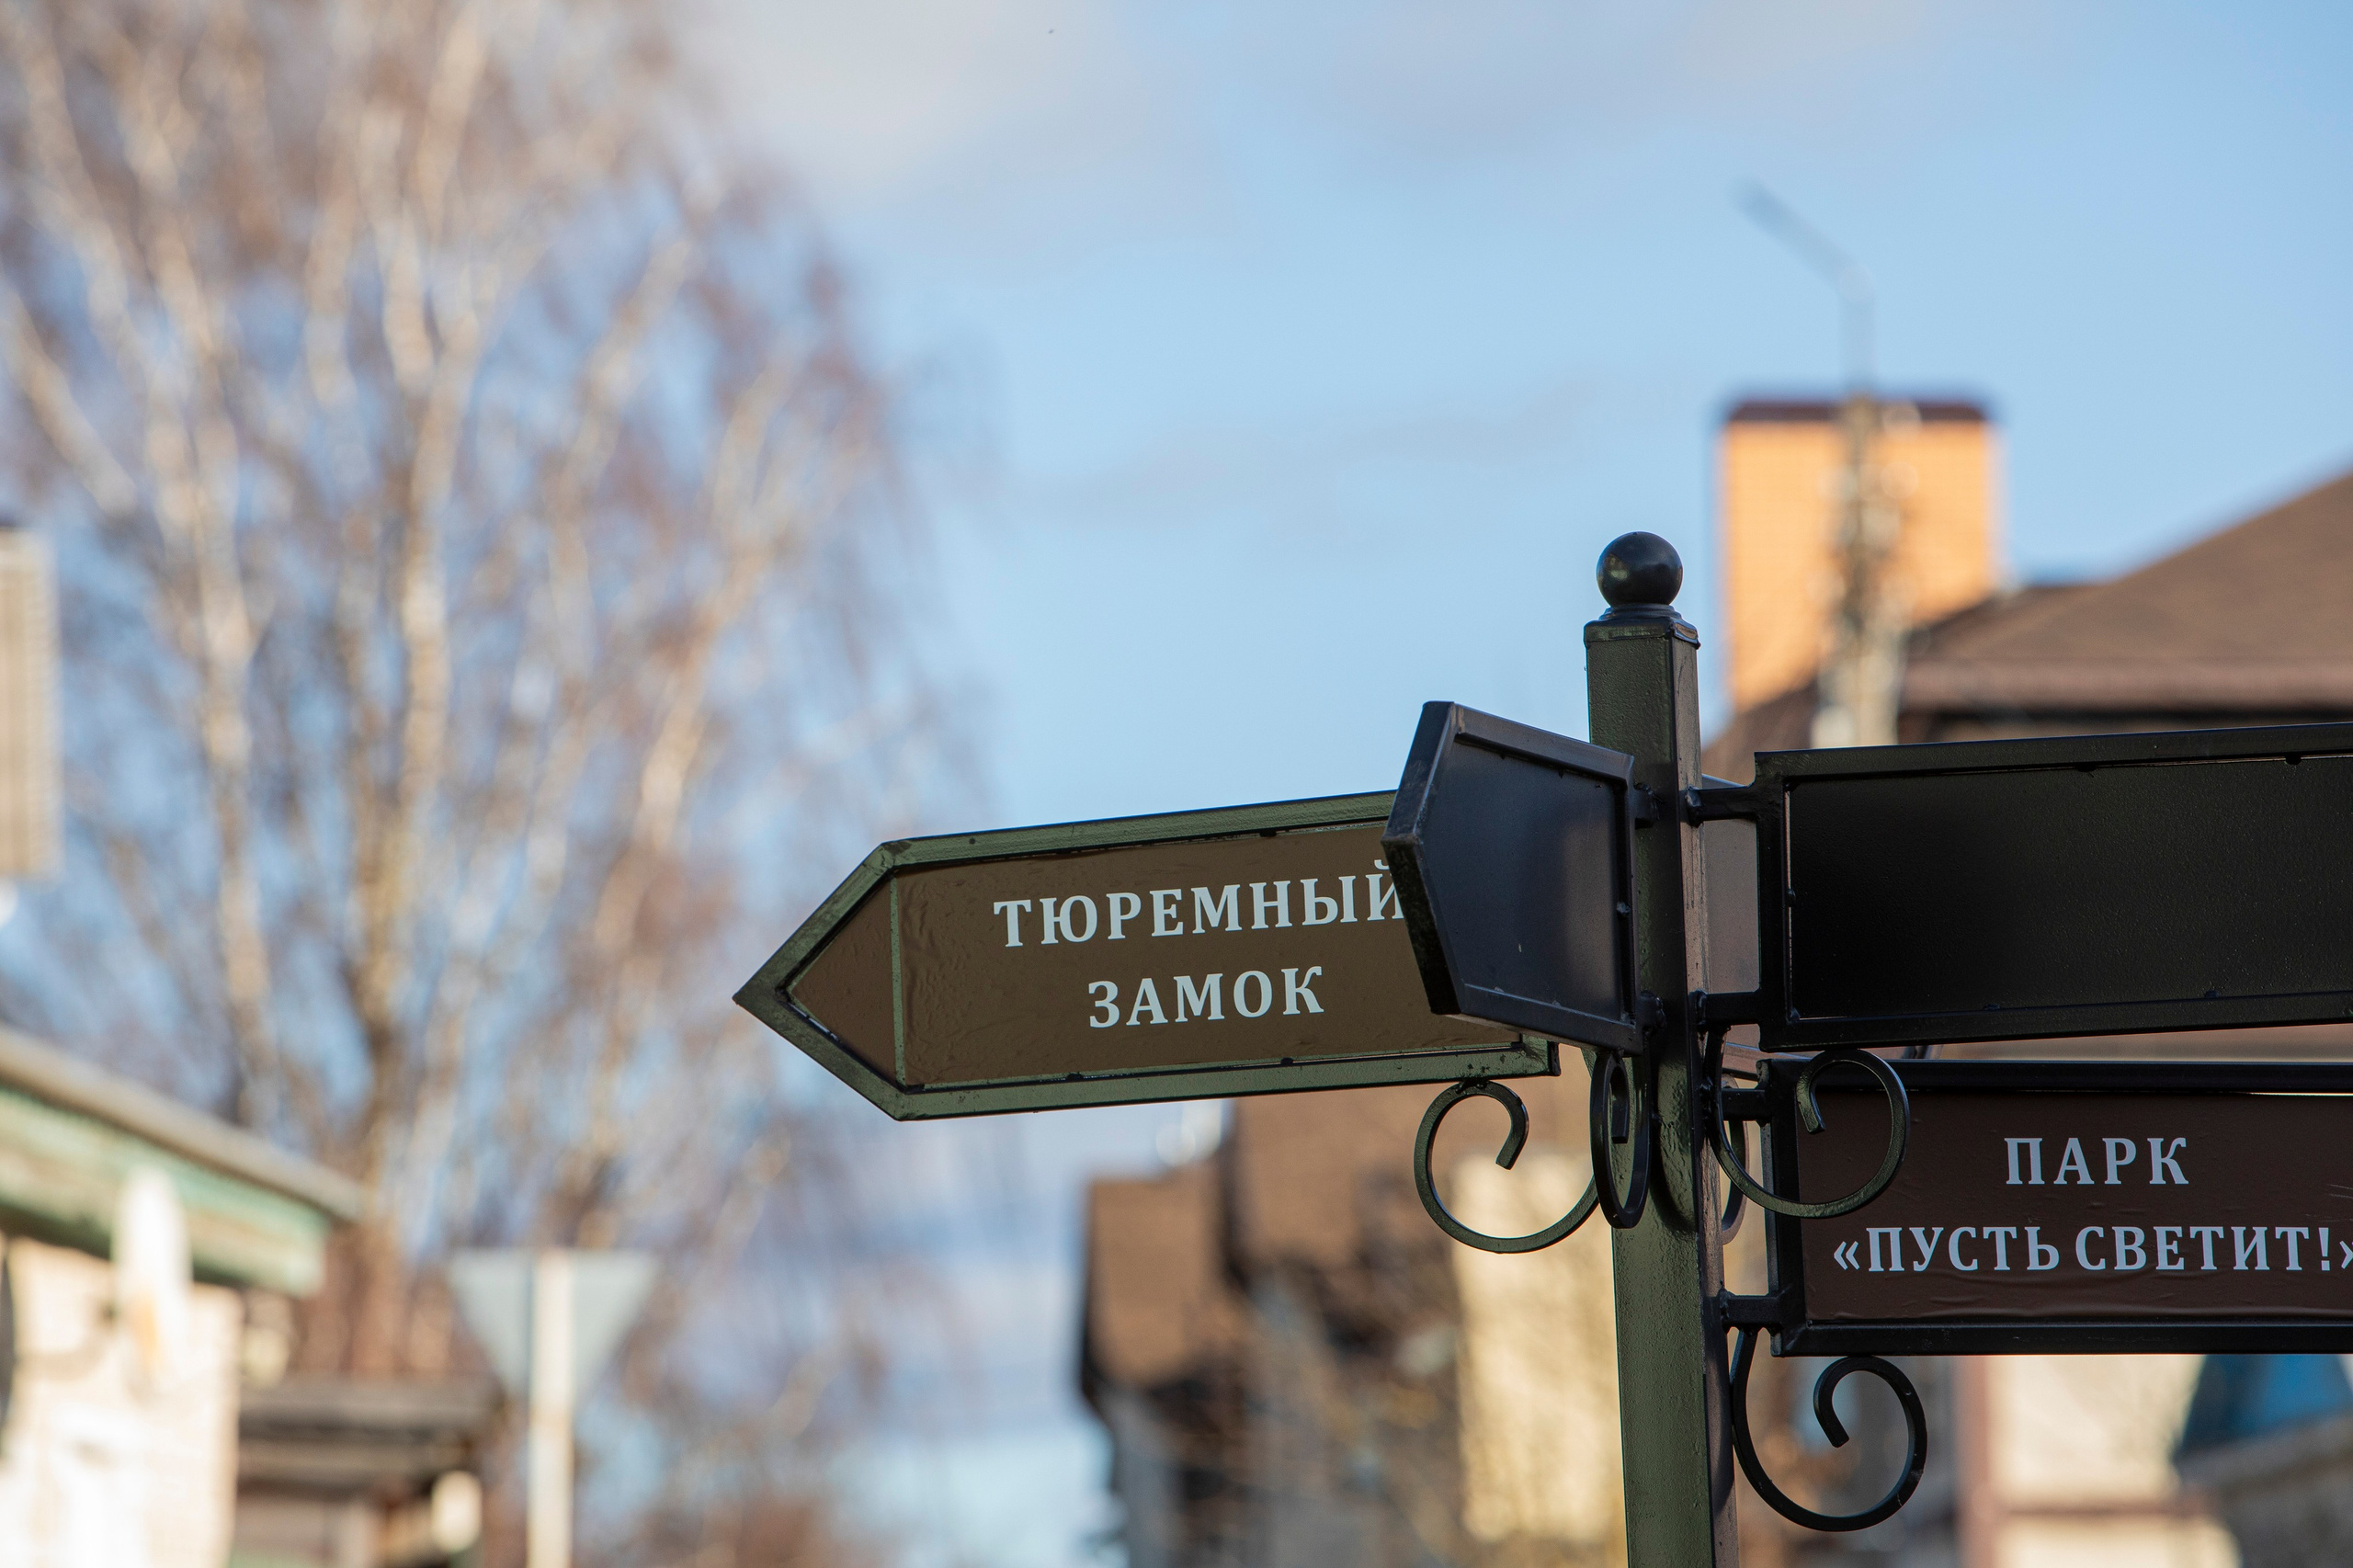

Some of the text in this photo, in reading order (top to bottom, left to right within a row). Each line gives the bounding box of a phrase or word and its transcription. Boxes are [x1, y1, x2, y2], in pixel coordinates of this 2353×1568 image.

[993, 858, 1405, 948] ТЮРЕМНЫЙ
[1088, 965, 1325, 1028] ЗАМОК
[2004, 1137, 2189, 1185] ПАРК
[1834, 1226, 2060, 1272] «ПУСТЬ
